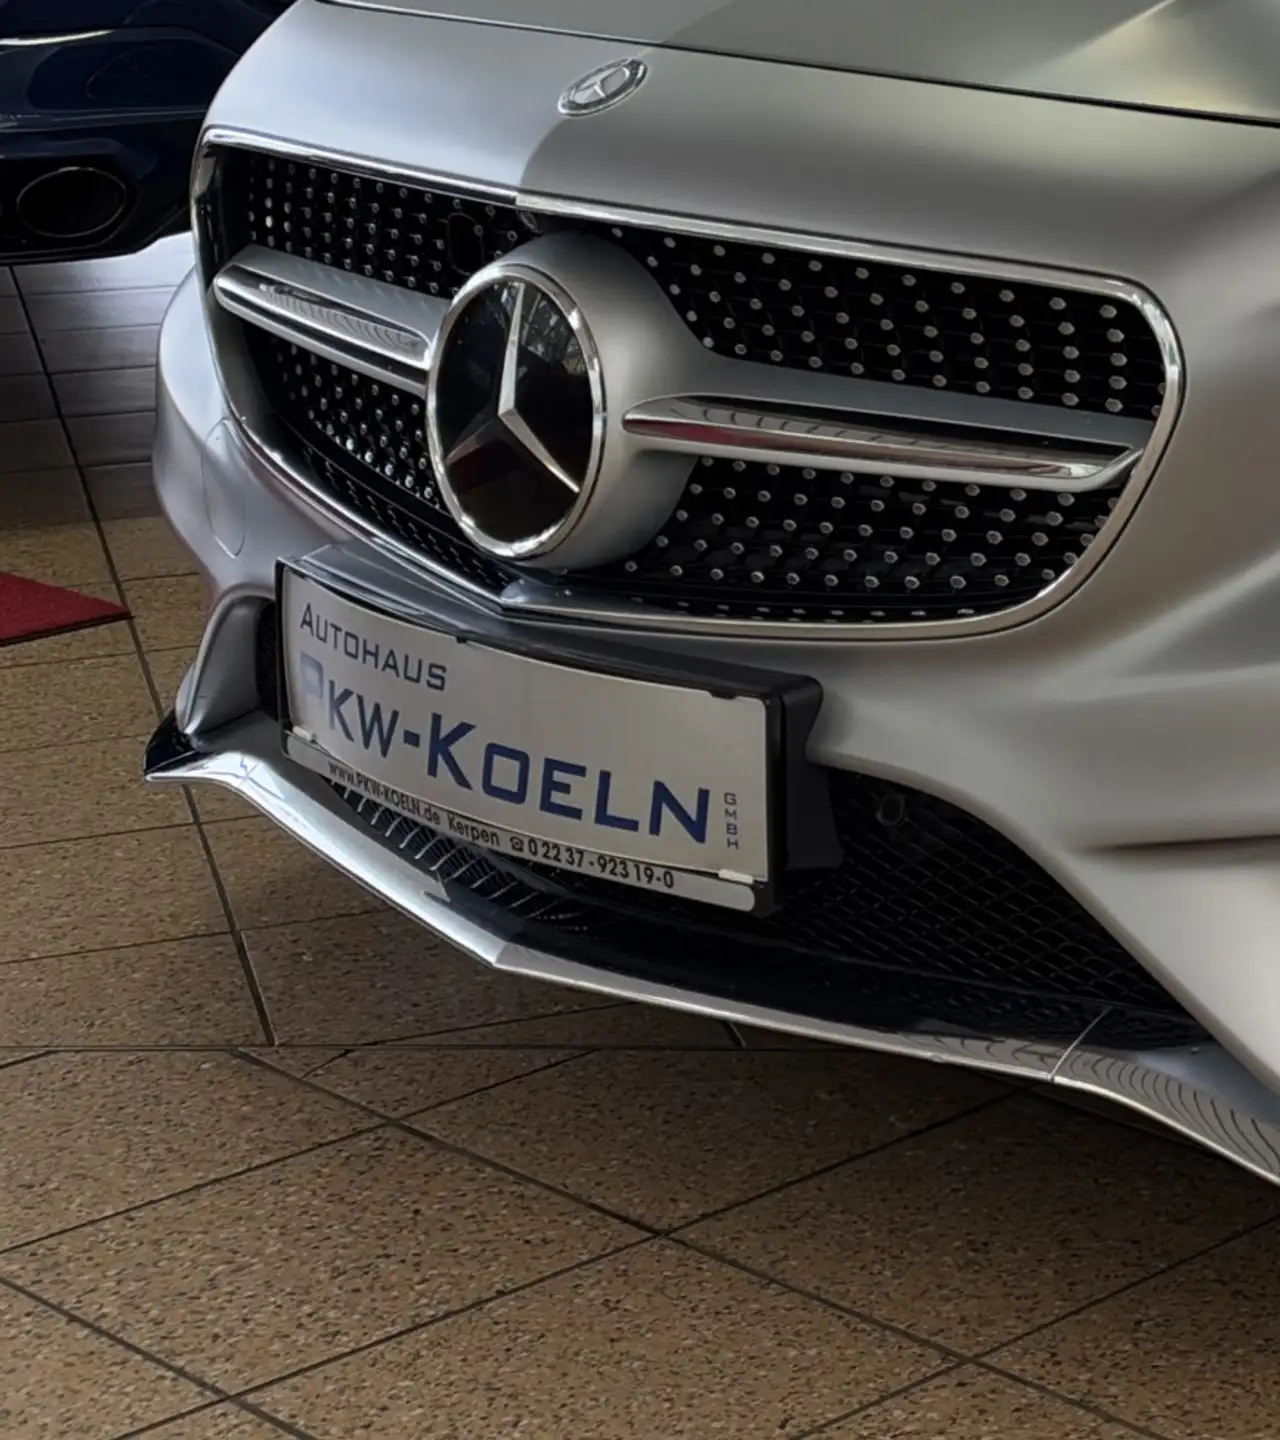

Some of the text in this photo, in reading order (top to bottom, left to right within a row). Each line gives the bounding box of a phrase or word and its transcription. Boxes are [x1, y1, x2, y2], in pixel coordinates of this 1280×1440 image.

[300, 603, 447, 691] AUTOHAUS
[300, 651, 709, 844] PKW-KOELN
[447, 813, 500, 847] Kerpen
